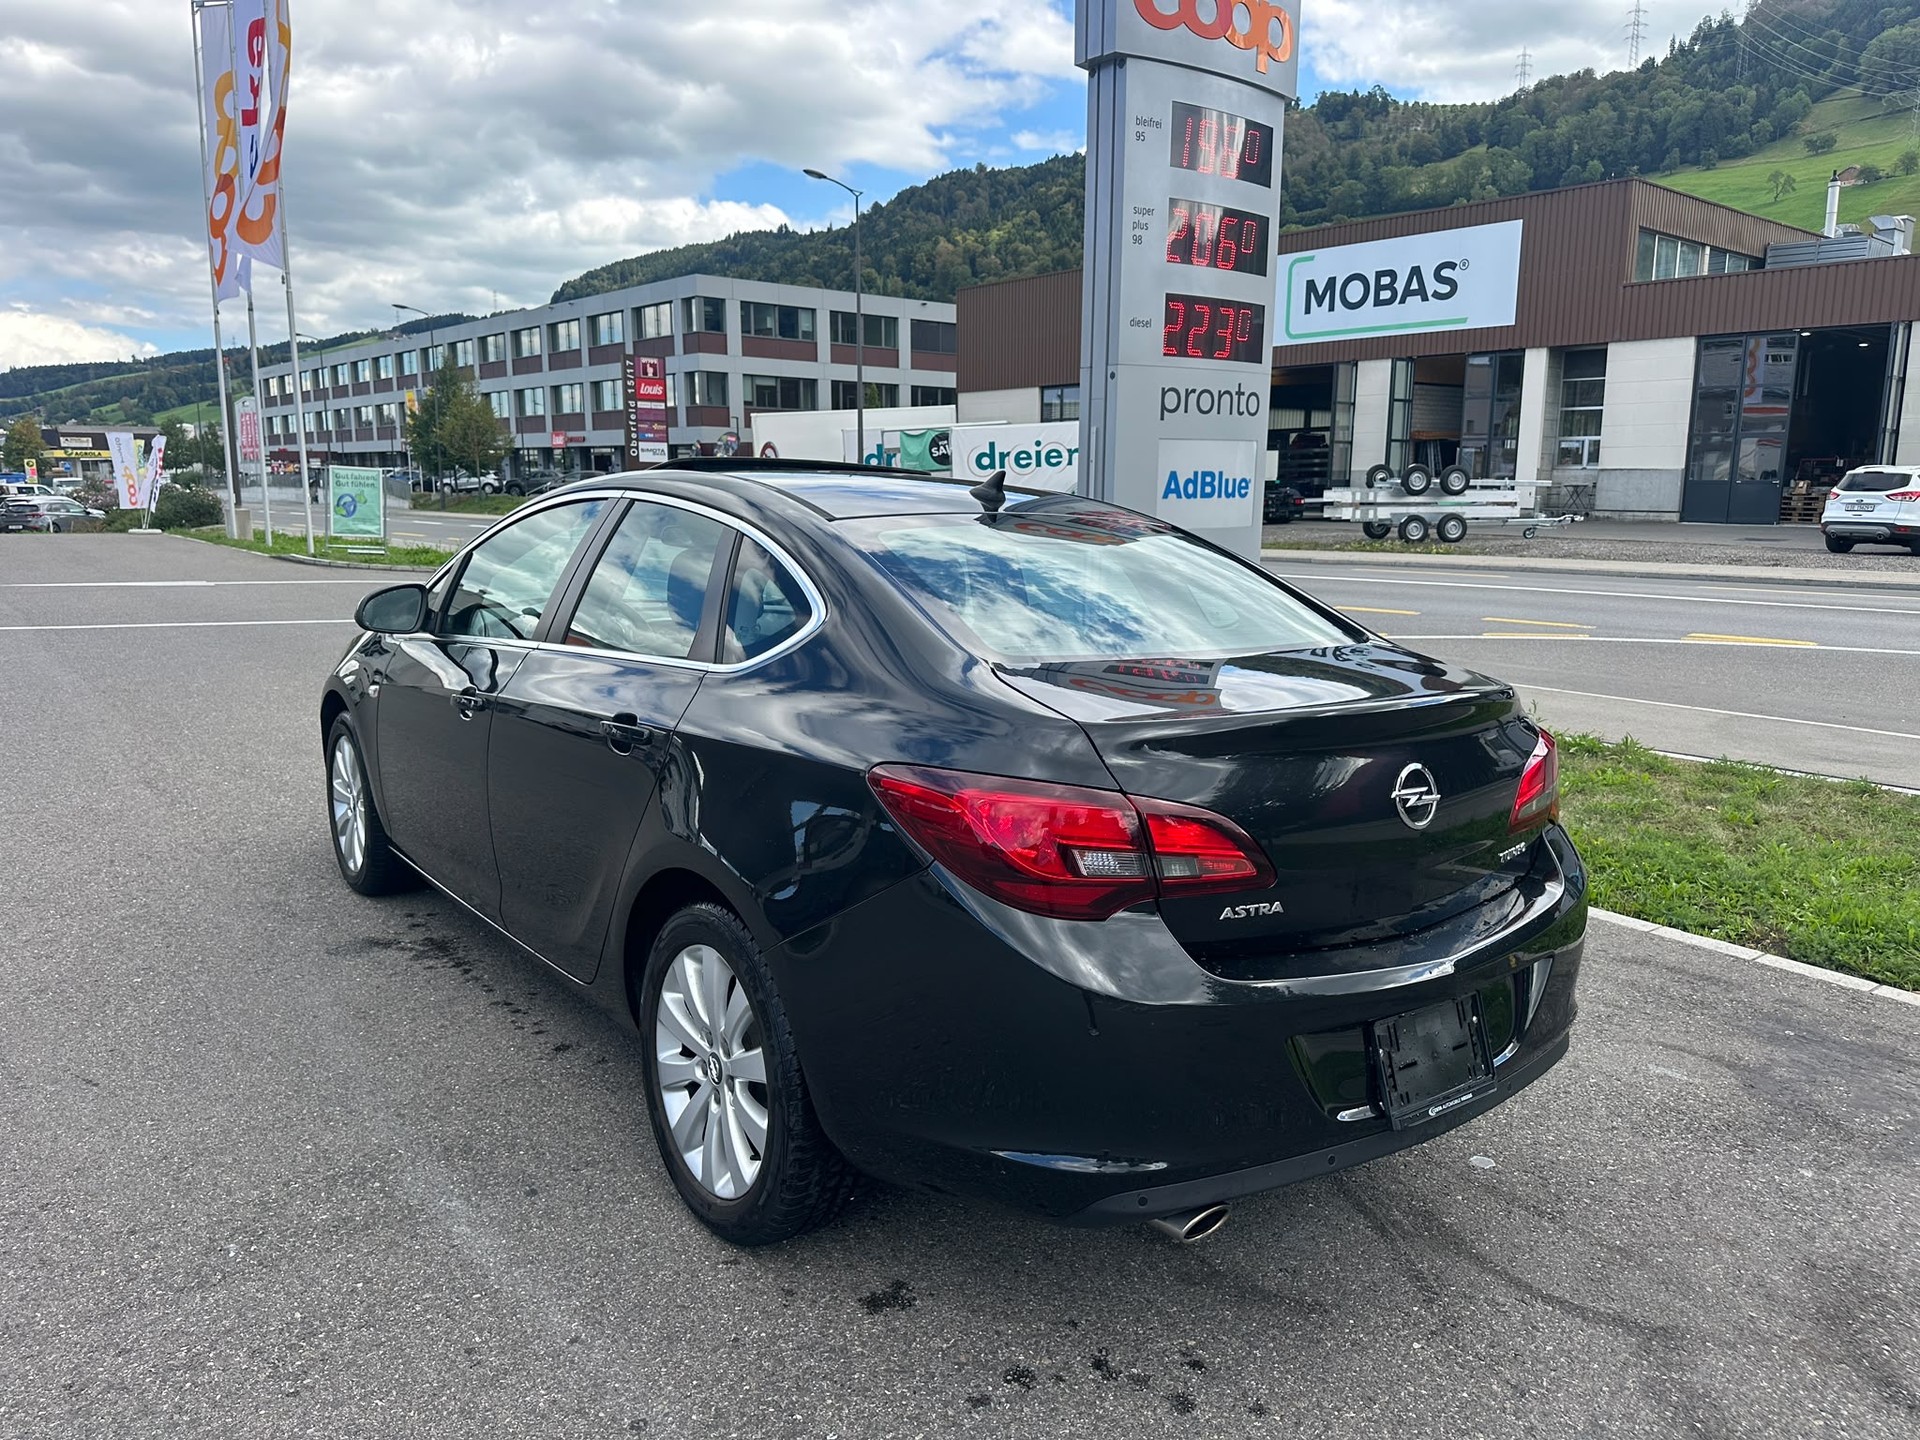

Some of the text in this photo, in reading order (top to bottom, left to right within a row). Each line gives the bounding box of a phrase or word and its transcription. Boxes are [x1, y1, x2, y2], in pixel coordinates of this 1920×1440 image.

[1133, 0, 1294, 75] coop
[1135, 115, 1162, 130] bleifrei
[1135, 131, 1146, 142] 95
[1132, 206, 1155, 218] super
[1132, 218, 1149, 231] plus
[1132, 235, 1143, 245] 98
[1129, 317, 1152, 328] diesel
[640, 382, 664, 396] Louis
[625, 360, 638, 457] Oberfeld 15/17
[1159, 383, 1260, 421] pronto
[975, 440, 1079, 471] dreier
[335, 473, 378, 481] Gut fahren.
[335, 480, 351, 488] Gut
[1162, 470, 1250, 499] AdBlue
[1219, 901, 1285, 921] ASTRA
